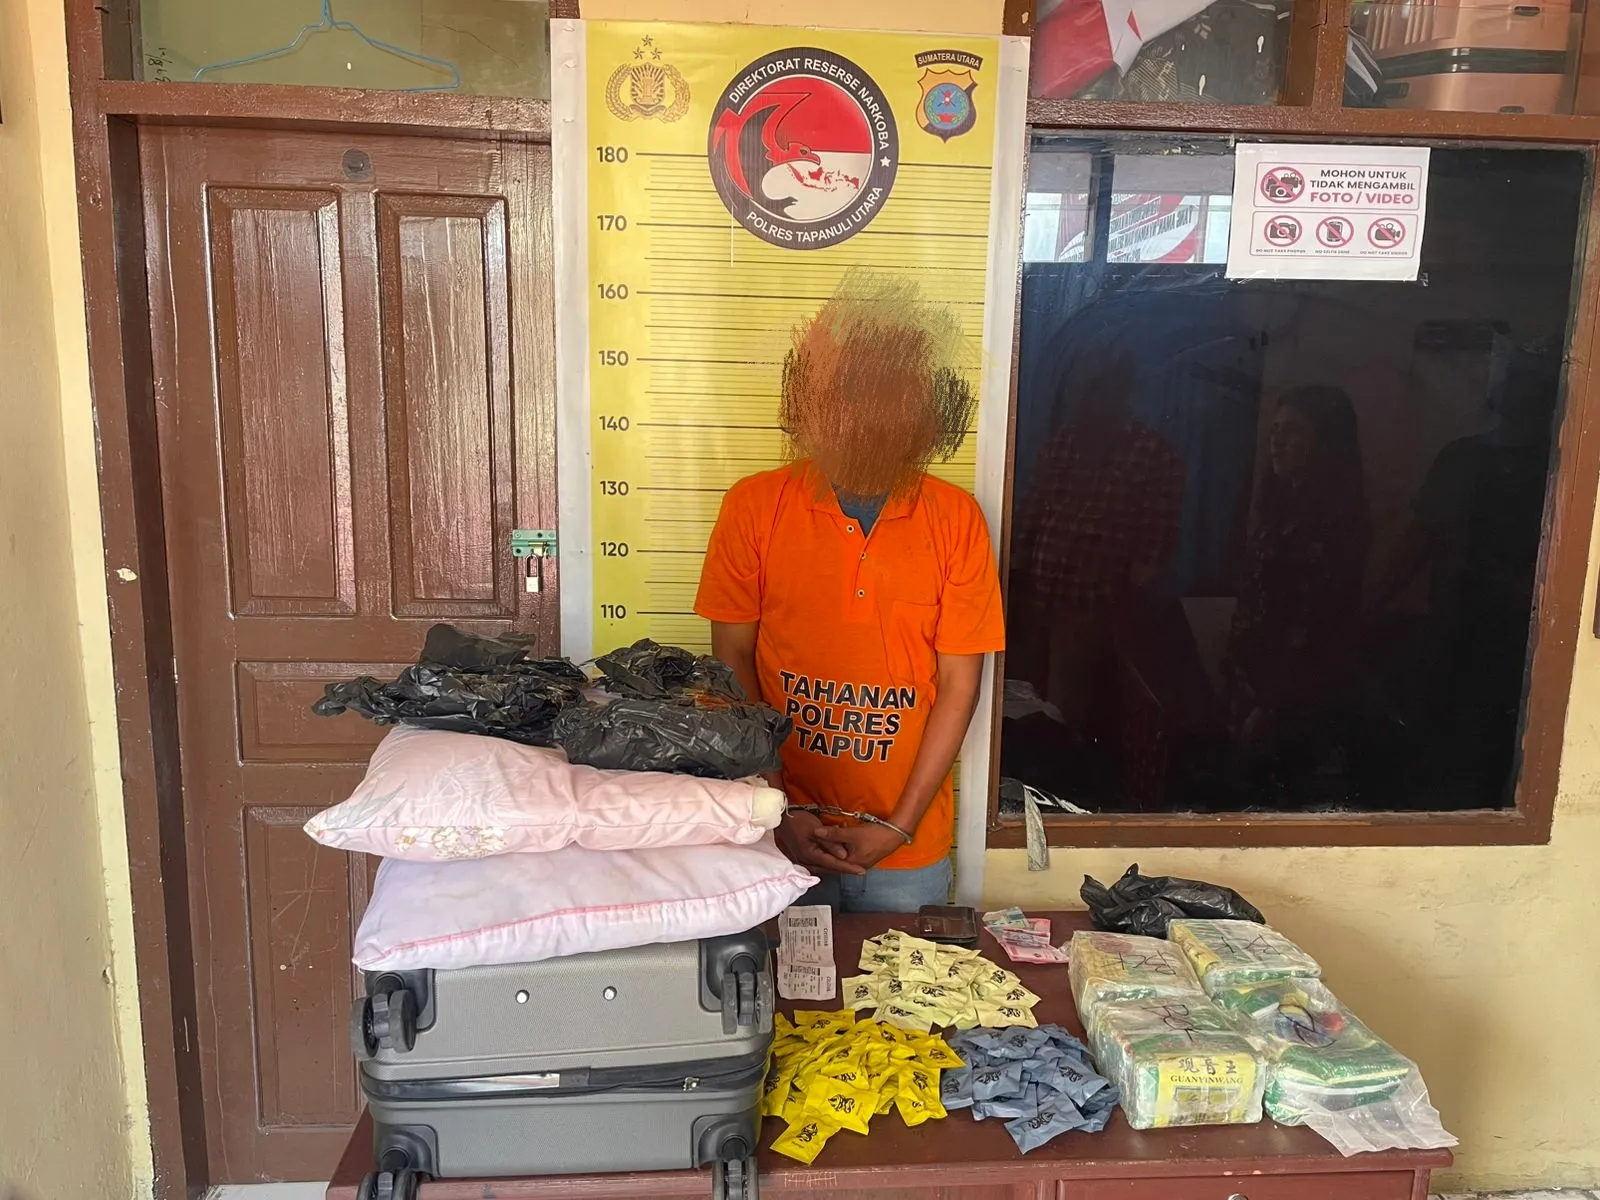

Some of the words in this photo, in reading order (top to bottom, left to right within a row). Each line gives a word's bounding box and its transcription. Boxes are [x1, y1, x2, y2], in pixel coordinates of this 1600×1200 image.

[918, 52, 956, 65] SUMATERA
[956, 54, 980, 68] UTARA
[729, 58, 801, 104] DIREKTORAT
[804, 58, 860, 91] RESERSE
[858, 86, 891, 150] NARKOBA
[597, 146, 629, 163] 180
[1320, 169, 1365, 179] MOHON
[1368, 171, 1407, 179] UNTUK
[1309, 180, 1346, 189] TIDAK
[1347, 181, 1416, 191] MENGAMBIL
[1310, 192, 1353, 203] FOTO
[1356, 191, 1362, 204] /
[1366, 193, 1414, 205] VIDEO
[746, 211, 793, 242] POLRES
[796, 219, 853, 242] TAPANULI
[850, 186, 883, 222] UTARA
[597, 215, 627, 231] 170
[598, 283, 629, 299] 160
[598, 350, 629, 366] 150
[599, 416, 629, 431] 140
[600, 480, 629, 496] 130
[600, 541, 629, 557] 120
[600, 604, 626, 619] 110
[779, 669, 916, 710] TAHANAN
[785, 696, 901, 736] POLRES
[794, 726, 894, 763] TAPUT
[1170, 1075, 1244, 1085] GUANYINWANG
